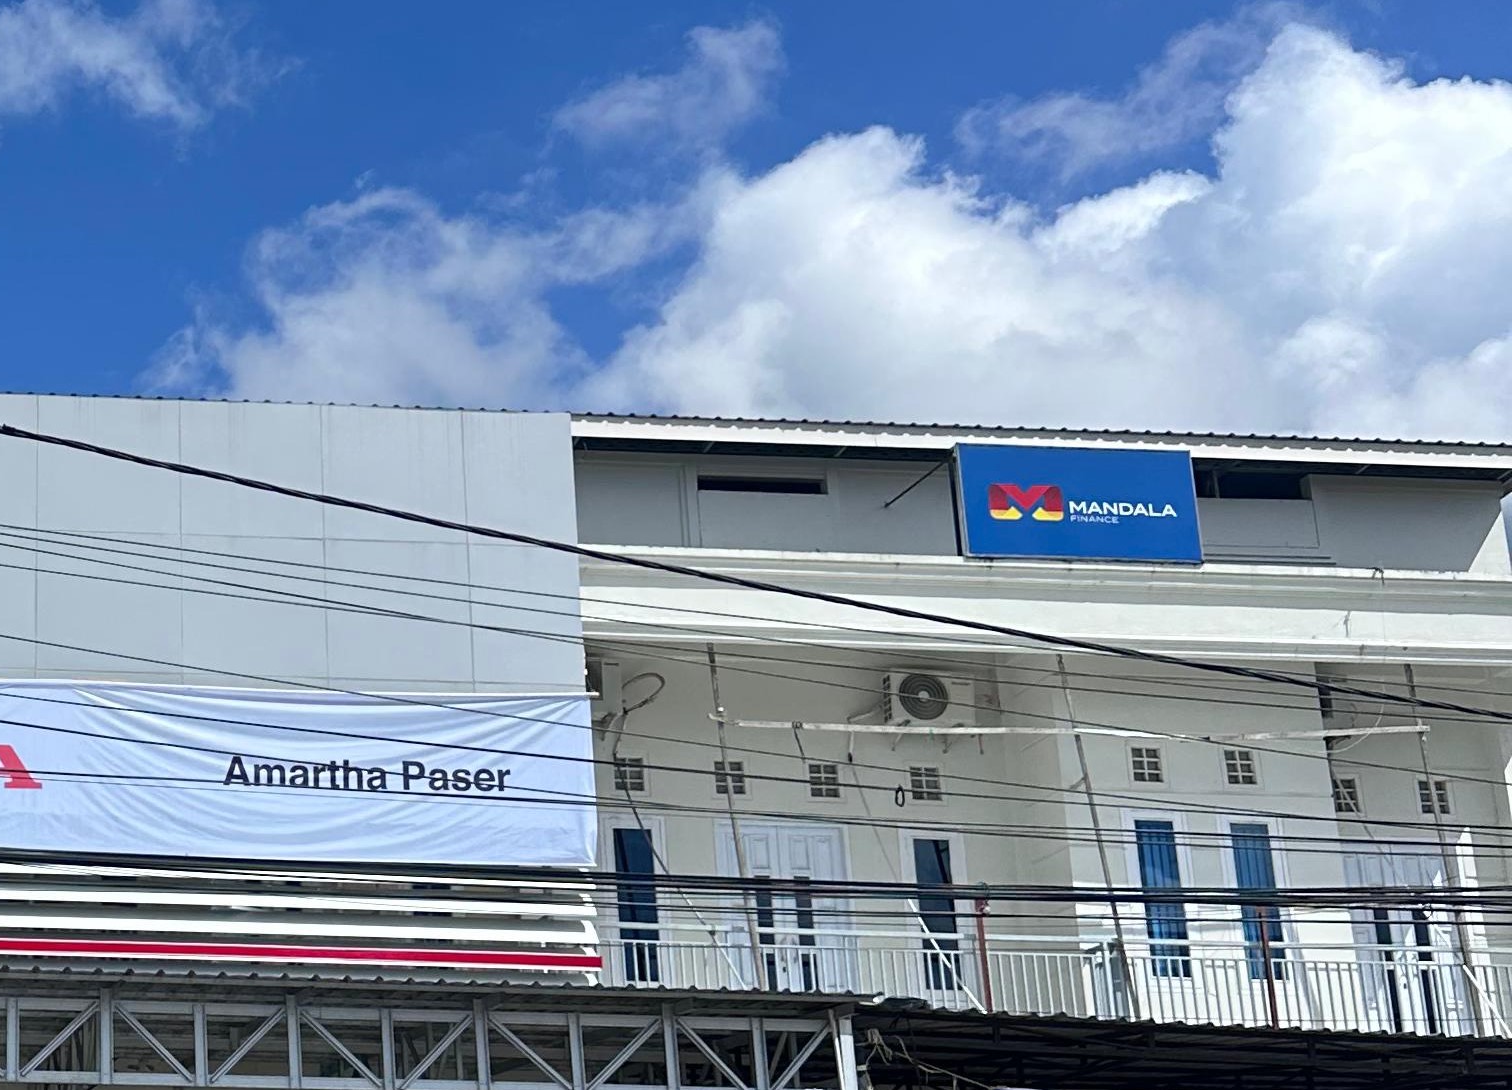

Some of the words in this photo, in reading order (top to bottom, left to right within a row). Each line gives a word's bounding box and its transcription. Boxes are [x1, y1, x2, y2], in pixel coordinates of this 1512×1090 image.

[1068, 500, 1178, 518] MANDALA
[1070, 514, 1120, 524] FINANCE
[222, 756, 386, 791] Amartha
[402, 760, 511, 792] Paser
